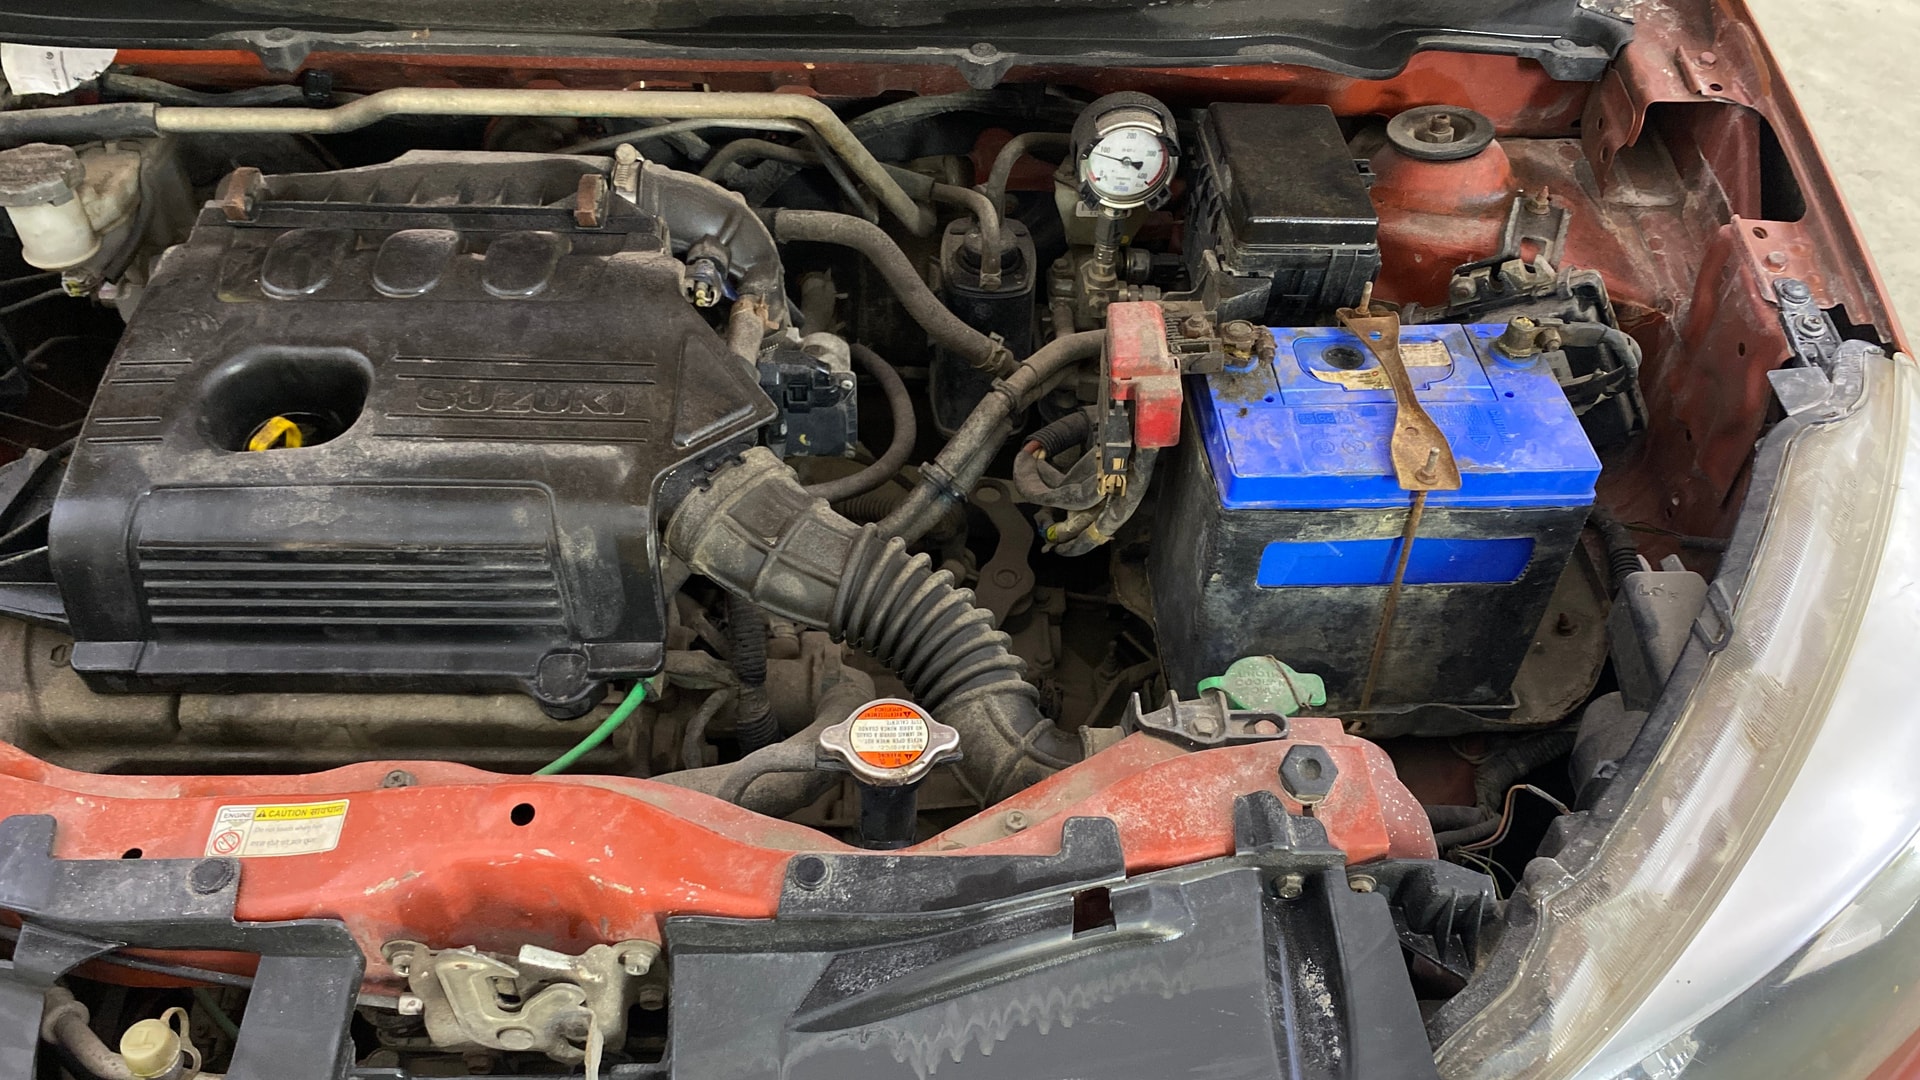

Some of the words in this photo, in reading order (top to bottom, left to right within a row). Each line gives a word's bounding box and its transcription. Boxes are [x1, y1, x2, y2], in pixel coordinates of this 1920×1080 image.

[415, 383, 627, 415] SUZUKI
[268, 809, 307, 818] CAUTION
[310, 804, 344, 815] सावधान
